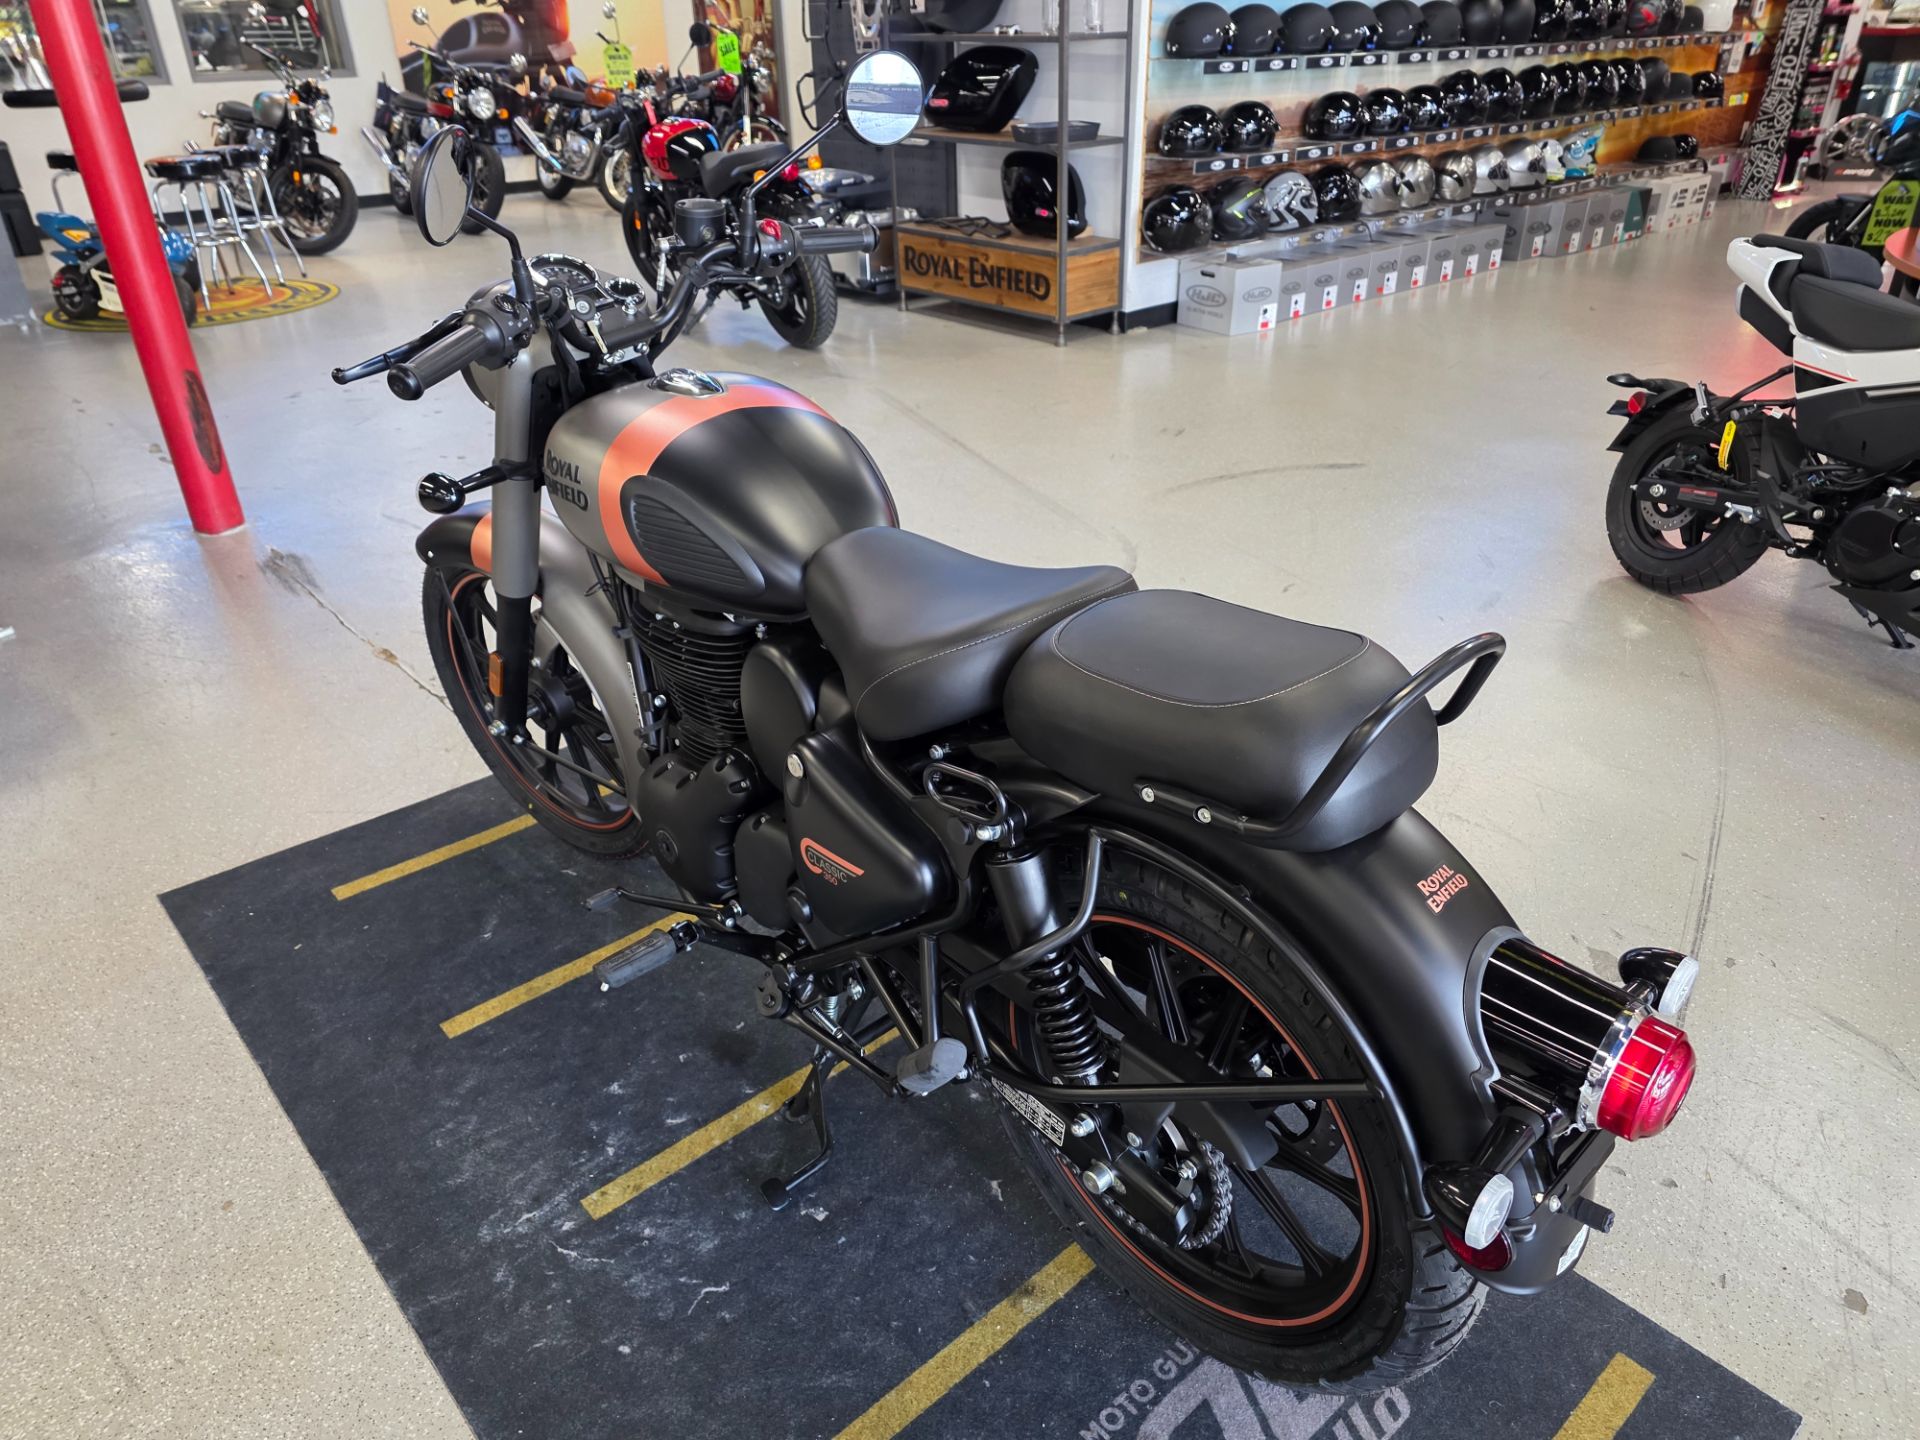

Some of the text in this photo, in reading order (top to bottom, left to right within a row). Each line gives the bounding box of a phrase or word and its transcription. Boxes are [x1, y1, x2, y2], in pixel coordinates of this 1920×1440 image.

[719, 41, 736, 57] SALE
[1882, 195, 1913, 204] WAS
[1873, 218, 1906, 228] NOW
[904, 245, 1050, 301] ROYAL ENFIELD
[546, 449, 581, 485] ROYAL
[807, 851, 848, 883] CLASSIC
[823, 871, 838, 886] 350
[1416, 864, 1454, 897] ROYAL
[1426, 873, 1468, 914] ENFIELD
